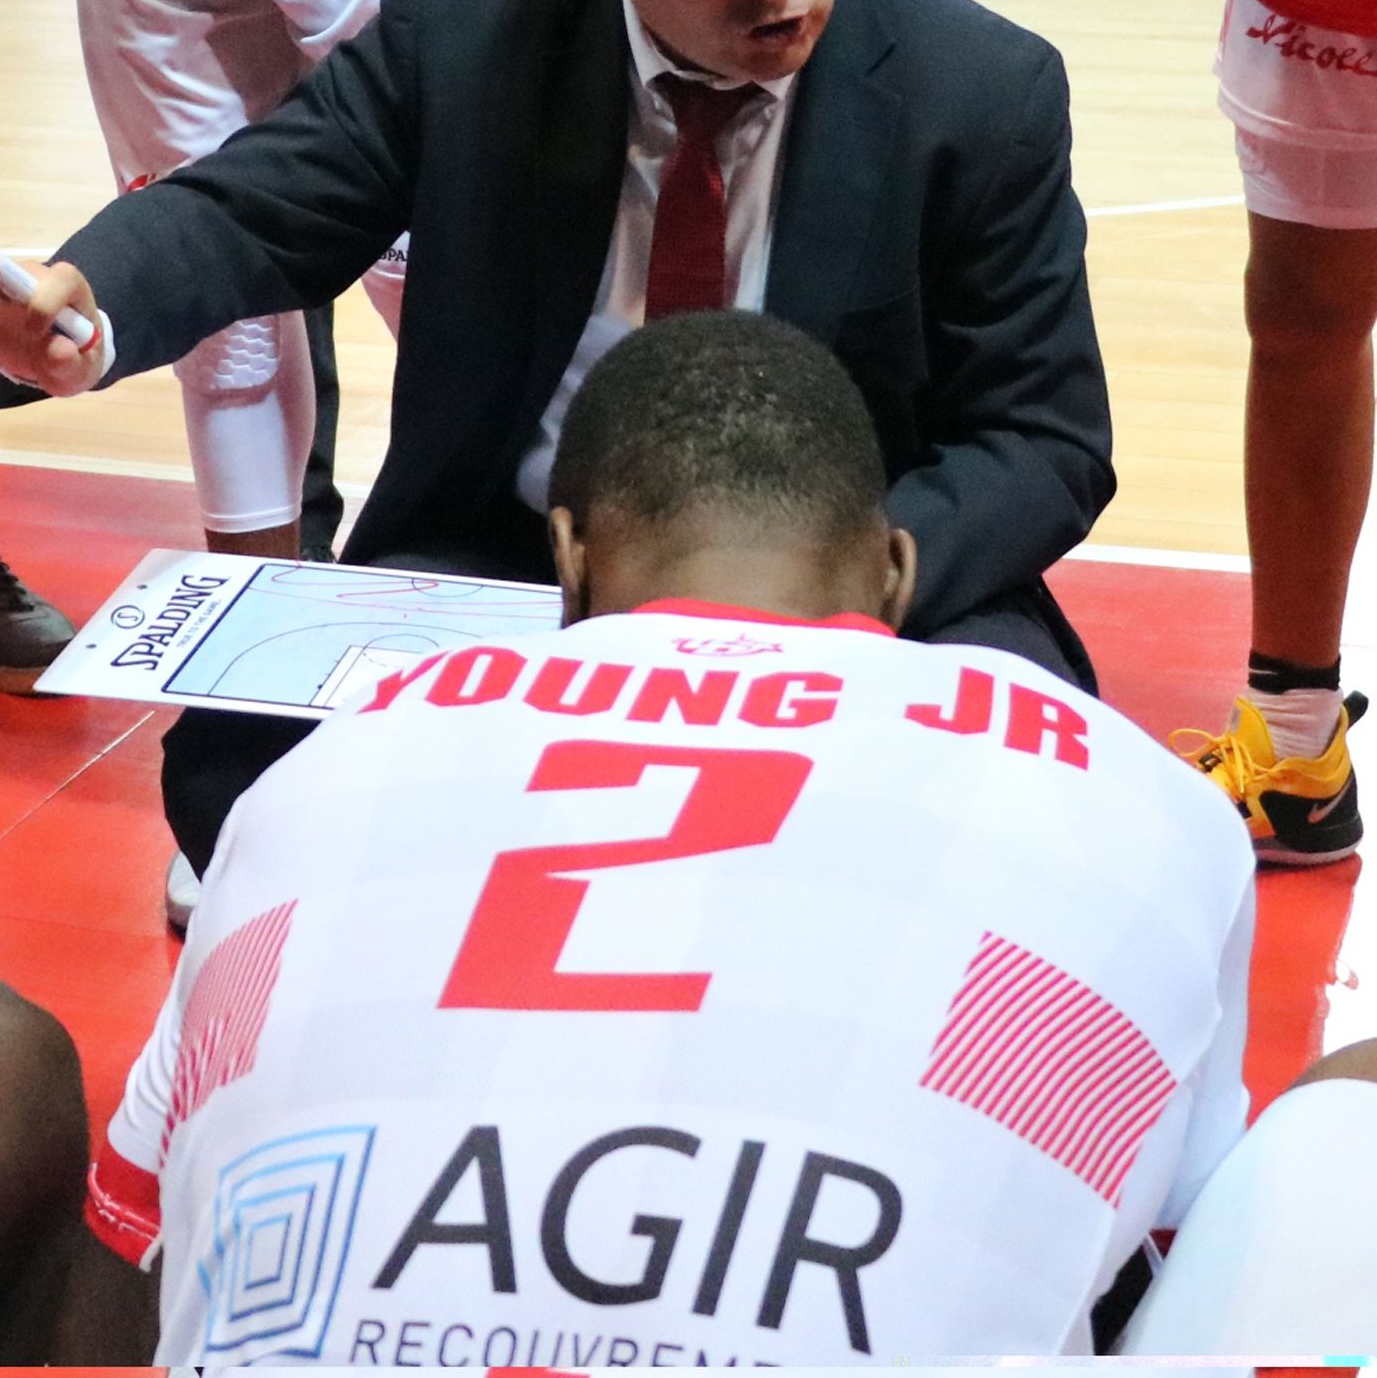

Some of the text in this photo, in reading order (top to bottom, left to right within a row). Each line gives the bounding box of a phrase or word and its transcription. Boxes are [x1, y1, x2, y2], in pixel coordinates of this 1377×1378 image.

[110, 574, 232, 671] SPALDING
[355, 645, 1089, 771] YOUNG JR
[436, 739, 813, 1012] 2
[372, 1125, 903, 1356] AGIR
